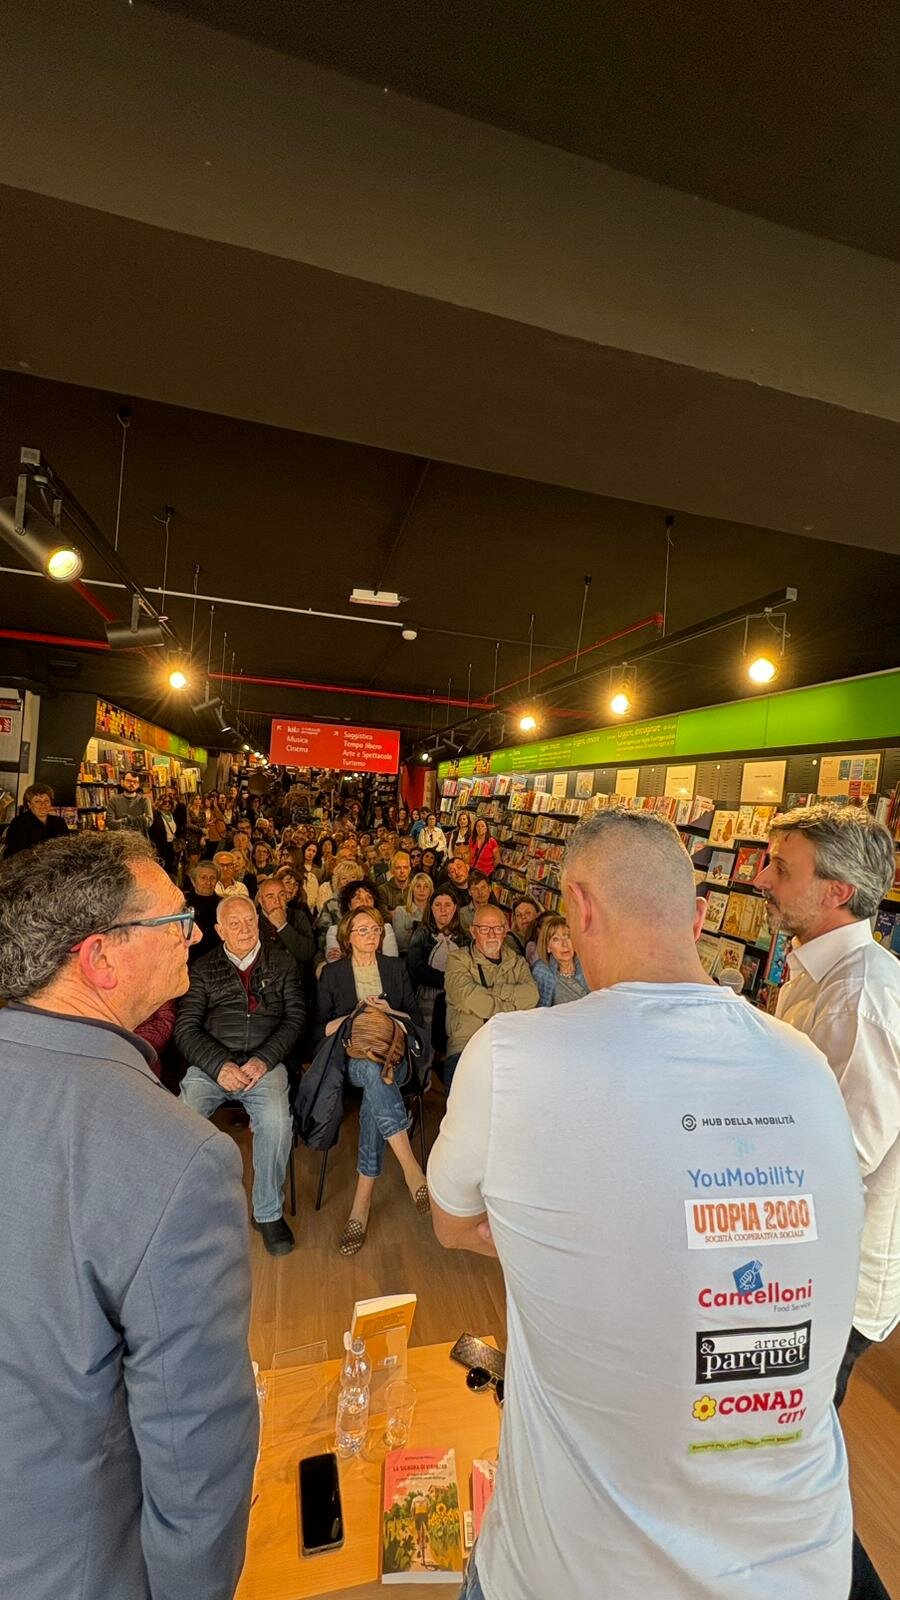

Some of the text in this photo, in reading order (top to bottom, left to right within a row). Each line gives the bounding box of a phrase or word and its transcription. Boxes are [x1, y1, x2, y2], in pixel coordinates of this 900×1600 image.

[286, 735, 308, 744] Musica
[343, 731, 373, 741] Saggistica
[286, 745, 308, 753] Cinema
[343, 740, 382, 750] Tempo libero
[362, 752, 393, 760] Spettacolo
[342, 759, 366, 767] Turismo
[702, 1114, 795, 1126] HUB DELLA MOBILITÀ
[687, 1166, 805, 1188] YouMobility
[693, 1199, 810, 1234] UTOPIA 2000
[705, 1229, 805, 1243] SOCIETÀ COOPERATIVA SOCIALE
[698, 1279, 812, 1308] Cancelloni
[773, 1301, 811, 1313] Food Service
[754, 1331, 806, 1349] arredo
[700, 1341, 714, 1354] &
[702, 1344, 807, 1380] parquet
[718, 1388, 804, 1415] CONAD
[777, 1406, 807, 1424] CITY
